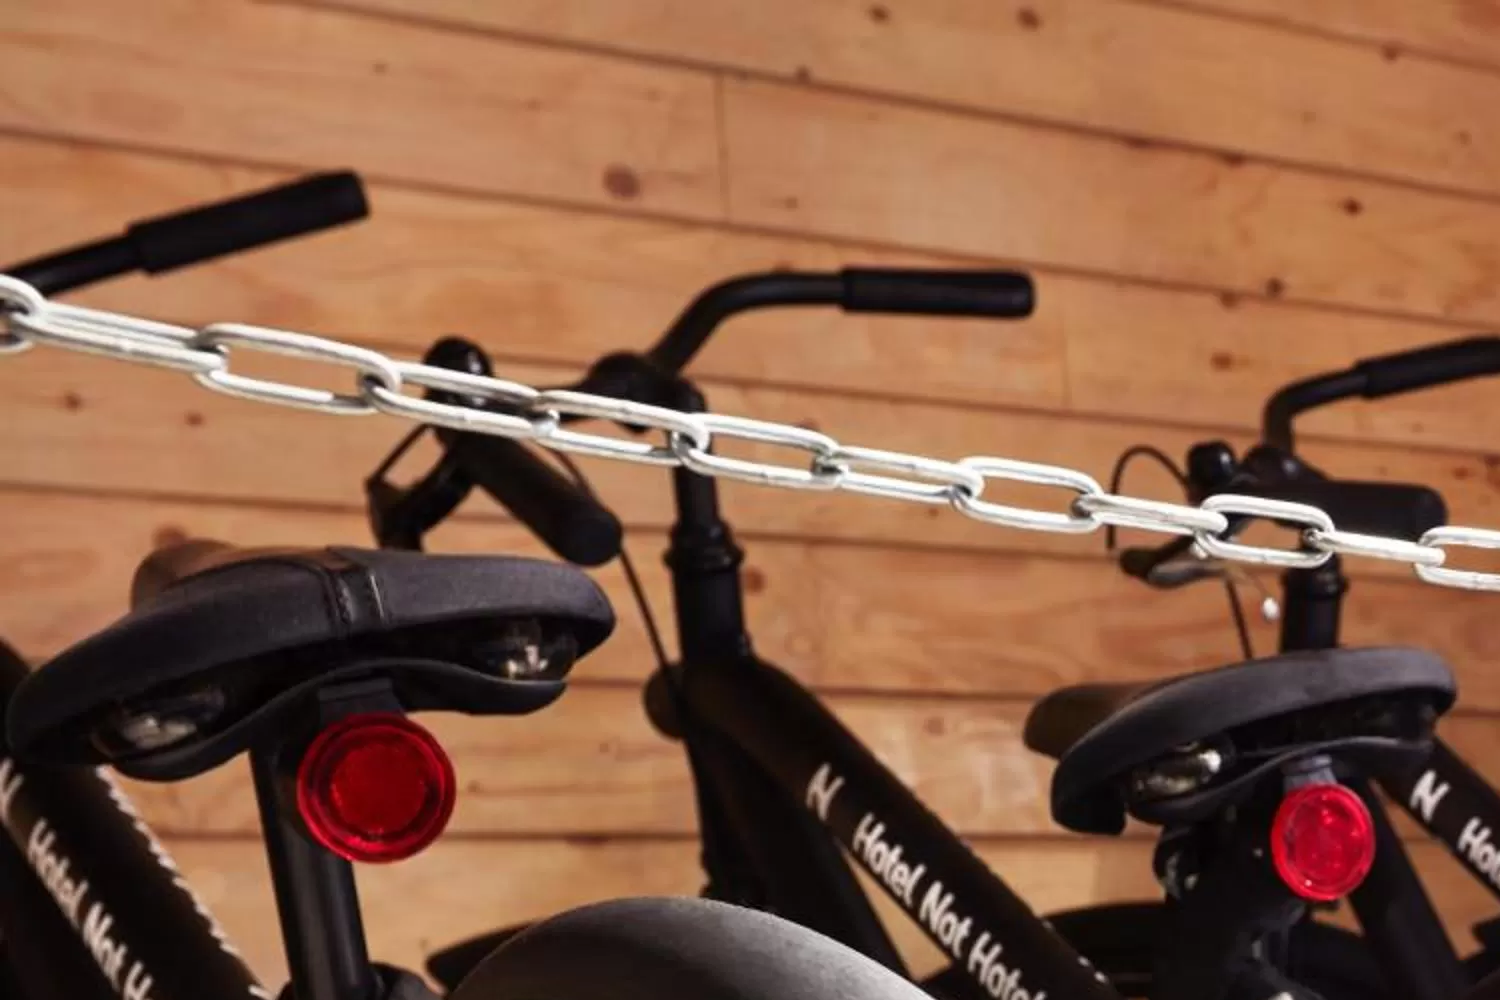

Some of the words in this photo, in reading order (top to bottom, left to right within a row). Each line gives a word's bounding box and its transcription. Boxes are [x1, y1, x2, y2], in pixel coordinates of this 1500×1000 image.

[805, 763, 845, 821] N
[853, 812, 926, 908] Hotel
[919, 881, 972, 958] Not
[1410, 769, 1450, 822] N
[28, 818, 88, 932] Hotel
[82, 902, 128, 992] Not
